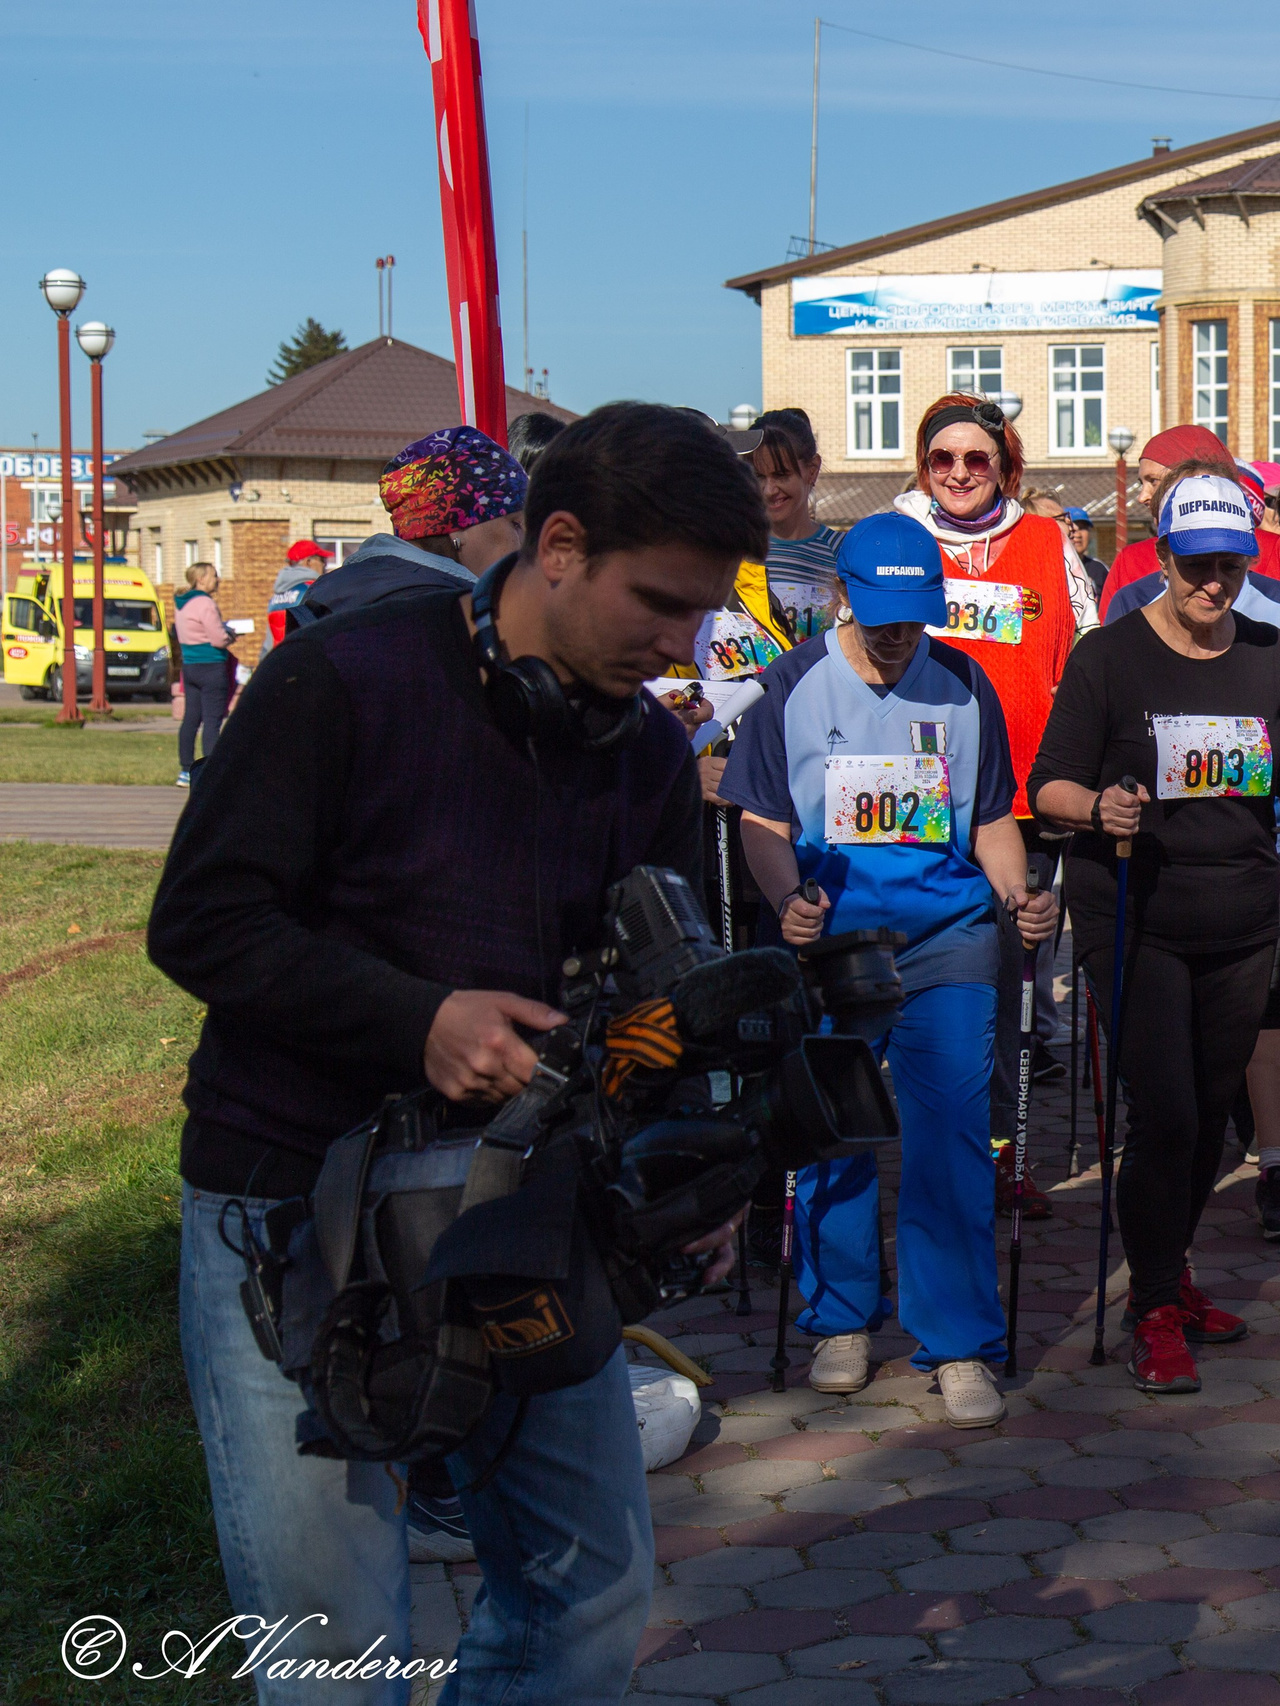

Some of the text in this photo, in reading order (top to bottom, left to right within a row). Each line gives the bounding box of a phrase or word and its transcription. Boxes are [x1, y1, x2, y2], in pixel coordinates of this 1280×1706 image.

[828, 306, 879, 320] ЦЕНТР
[886, 302, 1034, 318] ЭКОЛОГИЧЕСКОГО
[854, 313, 1138, 331] И ОПЕРАТИВНОГО РЕАГИРОВАНИЯ
[1178, 499, 1246, 518] ШЕРБАКУЛЬ
[876, 566, 925, 576] ШЕРБАКУЛЬ
[784, 606, 813, 636] 31
[946, 601, 997, 633] 836
[710, 635, 759, 669] 837
[1185, 749, 1245, 788] 803
[855, 792, 920, 833] 802
[1017, 1048, 1031, 1120] СЕВЕРНАЯ
